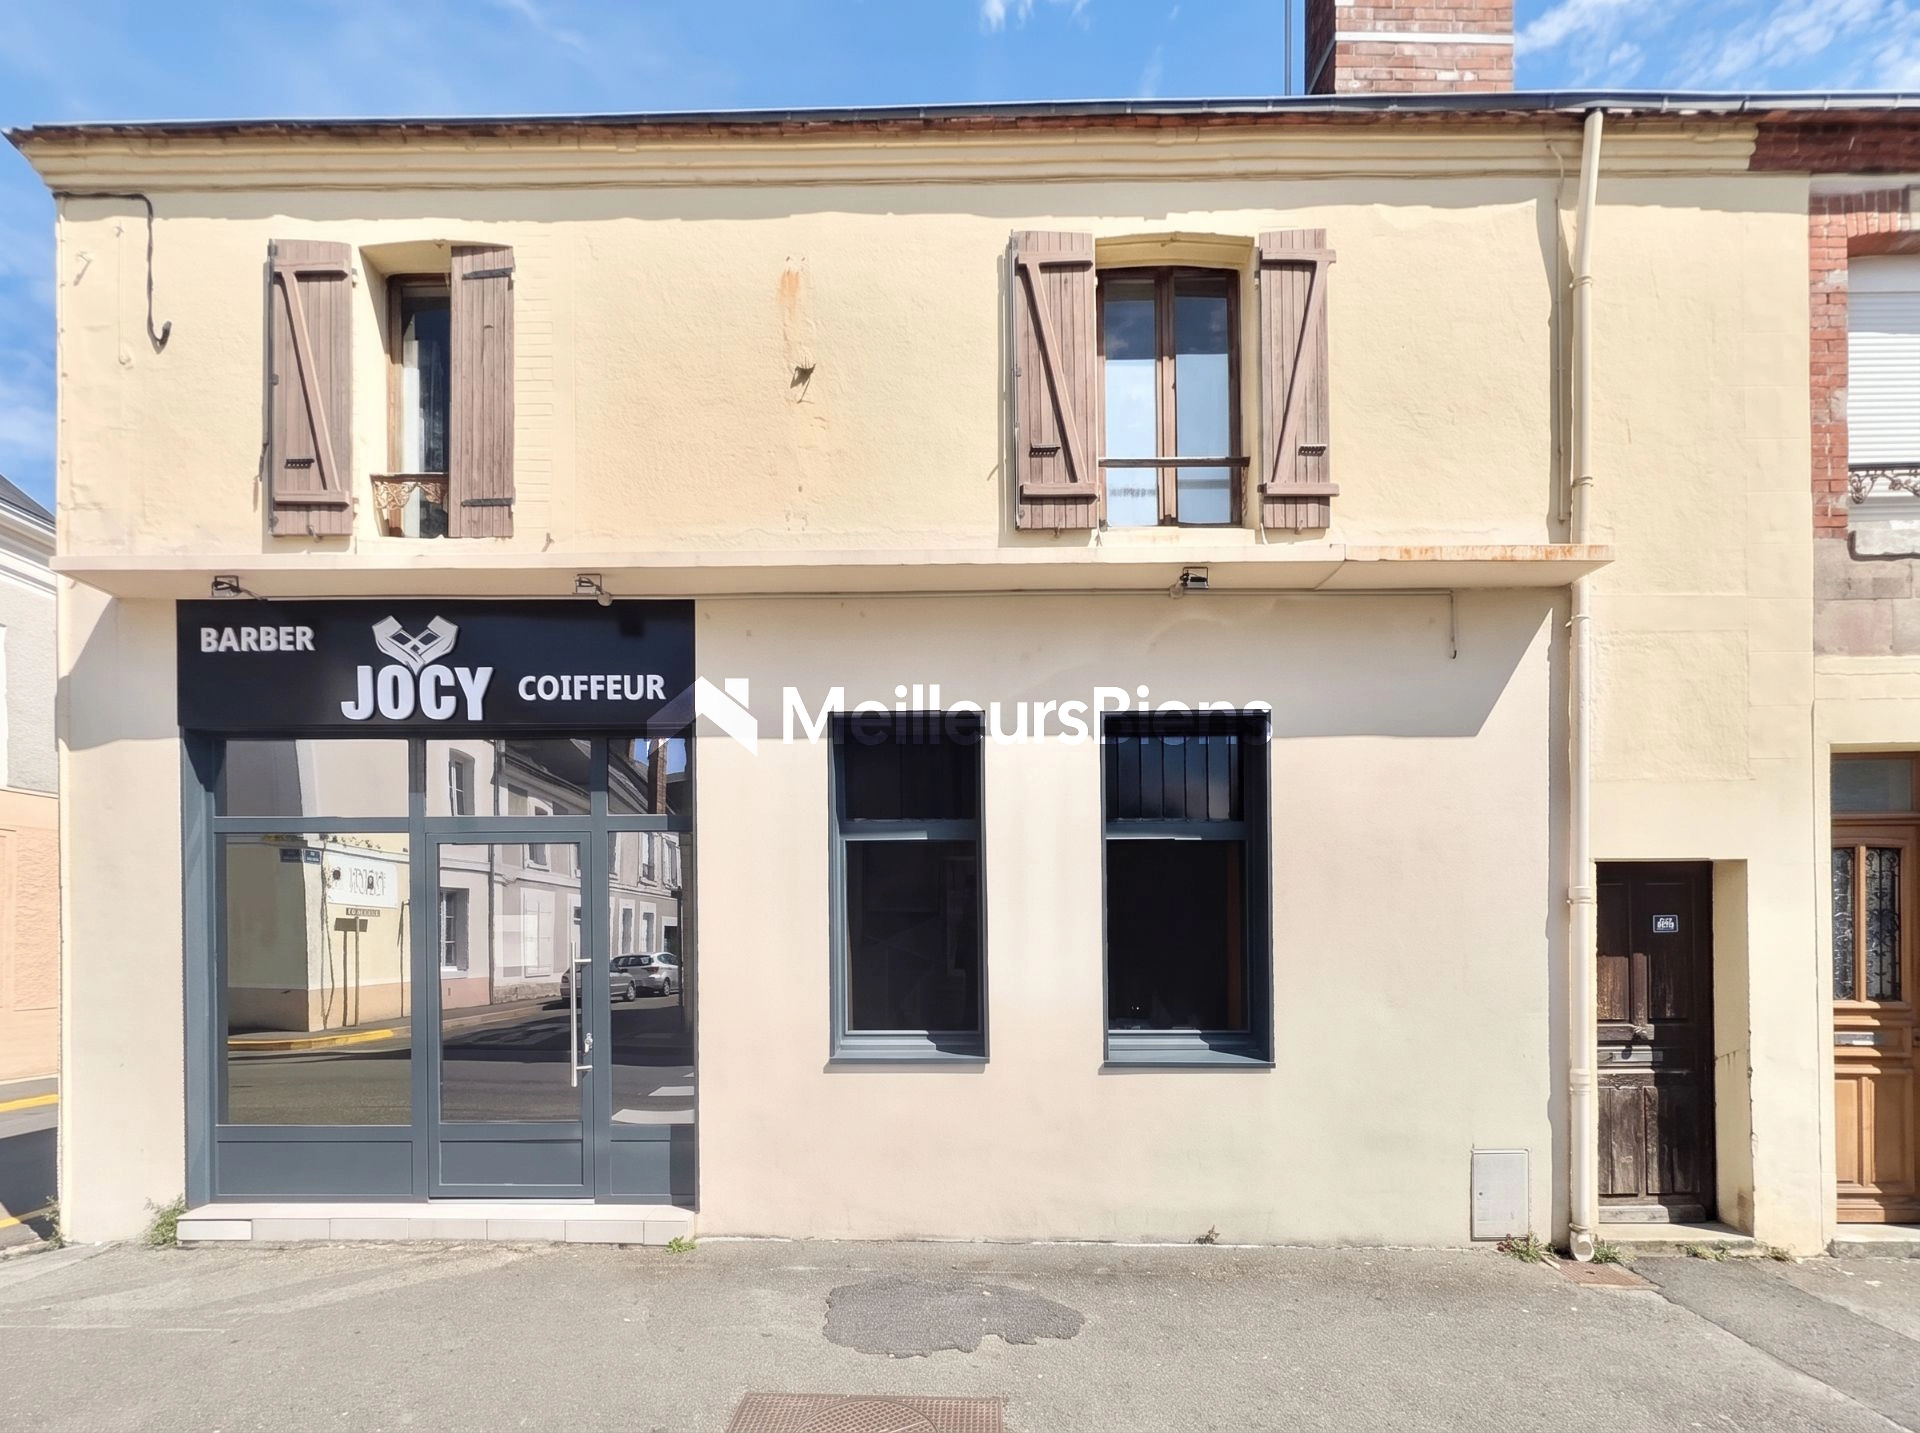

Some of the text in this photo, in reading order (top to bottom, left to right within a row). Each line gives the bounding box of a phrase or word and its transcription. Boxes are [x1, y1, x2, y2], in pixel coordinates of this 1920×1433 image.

[200, 626, 315, 652] BARBER
[340, 665, 494, 721] JOCY
[518, 674, 666, 702] COIFFEUR
